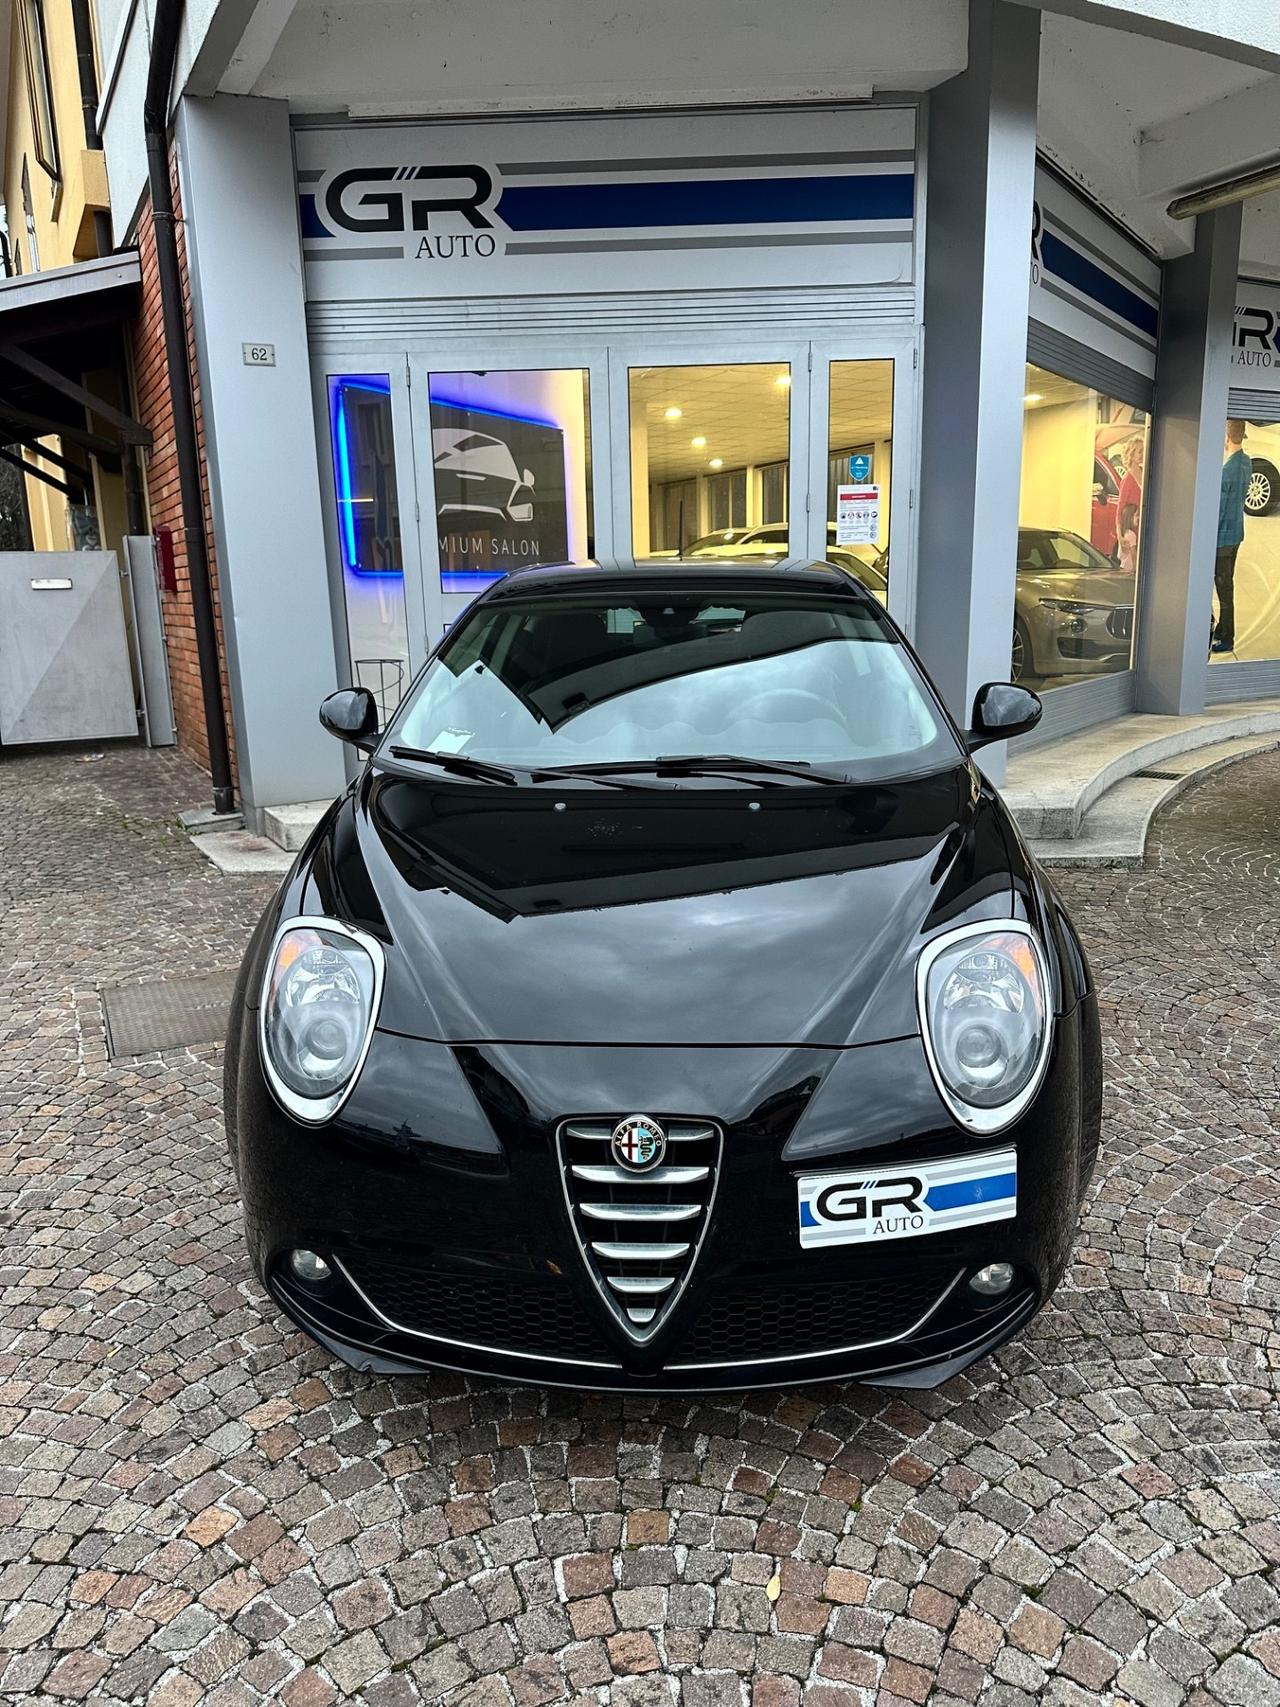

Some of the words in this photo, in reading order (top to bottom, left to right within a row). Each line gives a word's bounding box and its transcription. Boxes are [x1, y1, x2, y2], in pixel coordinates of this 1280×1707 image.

[325, 164, 495, 233] GR
[414, 234, 496, 259] AUTO
[251, 347, 268, 361] 62
[1237, 350, 1272, 368] AUTO
[491, 538, 540, 557] SALON
[614, 1123, 632, 1147] ALFA
[636, 1120, 663, 1147] ROMEO
[816, 1176, 924, 1222] GR
[872, 1215, 925, 1235] AUTO
